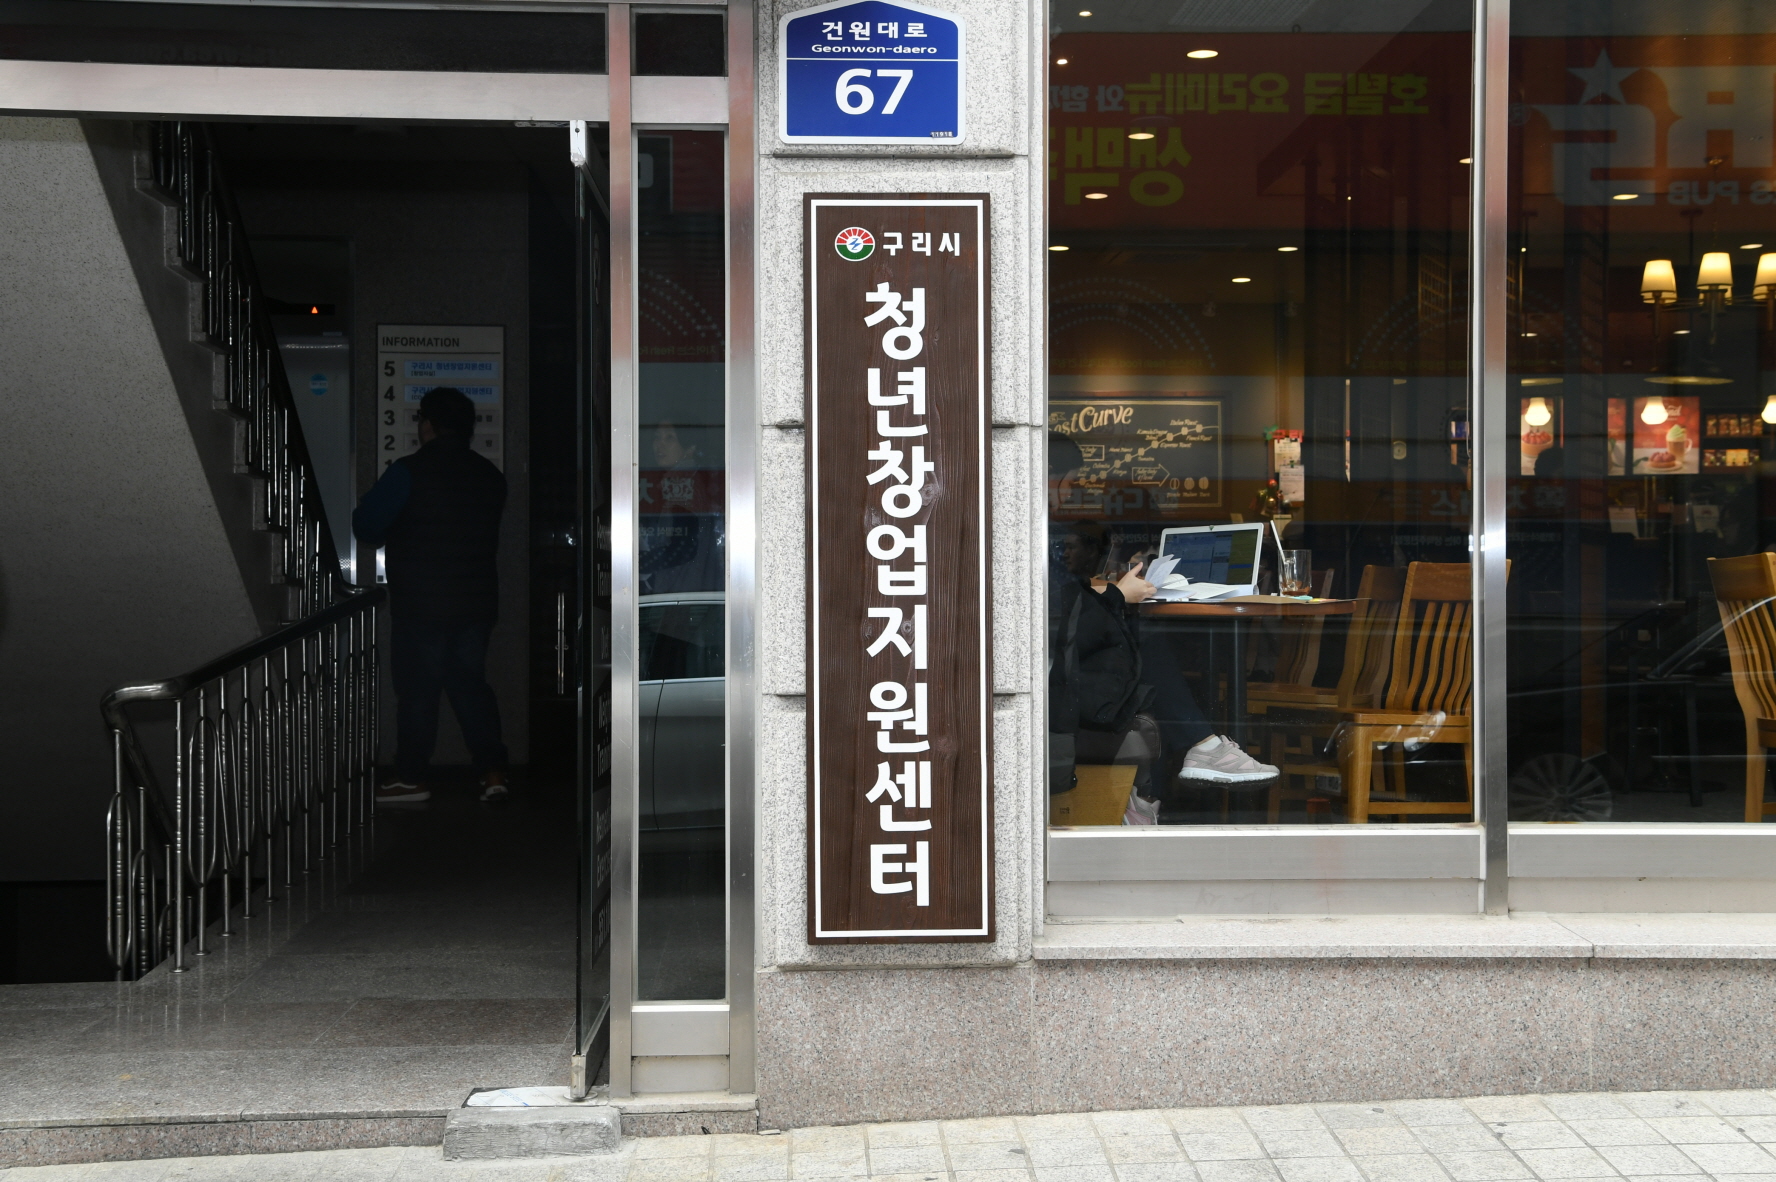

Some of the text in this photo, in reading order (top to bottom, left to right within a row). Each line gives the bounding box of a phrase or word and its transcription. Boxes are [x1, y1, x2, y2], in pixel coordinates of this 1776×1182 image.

[822, 21, 928, 41] 건원대로
[811, 44, 938, 54] Geonwon-daero
[835, 68, 914, 115] 67
[882, 231, 961, 256] 구리시
[382, 336, 460, 347] INFORMATION
[384, 361, 396, 377] 5
[384, 386, 396, 401] 4
[384, 410, 396, 426] 3
[1078, 405, 1134, 433] Curve
[384, 435, 396, 451] 2
[864, 281, 935, 907] 청년창업지원센터
